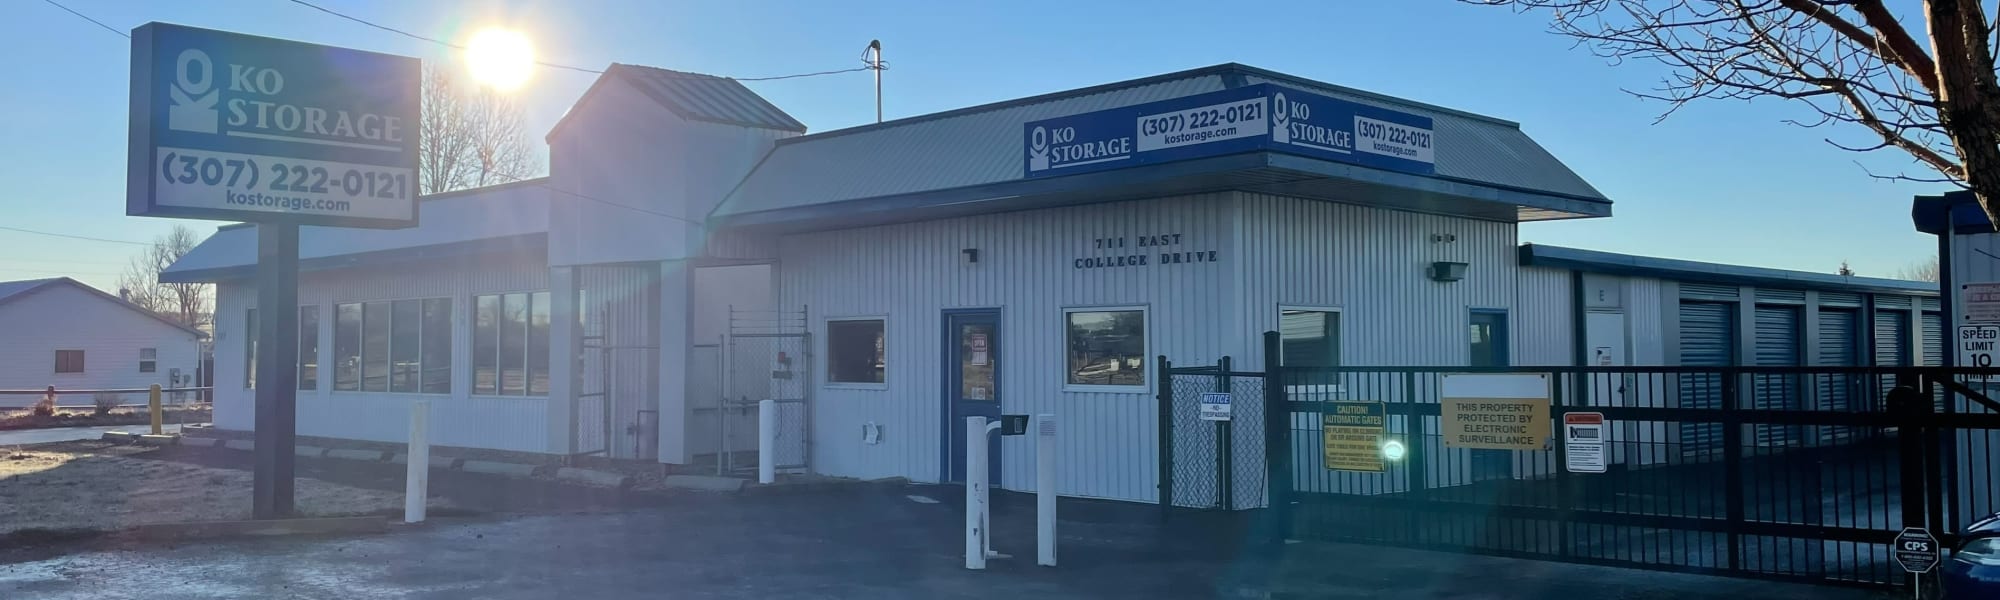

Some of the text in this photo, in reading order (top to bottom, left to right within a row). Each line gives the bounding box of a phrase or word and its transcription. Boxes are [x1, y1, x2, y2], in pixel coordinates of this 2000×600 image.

[229, 64, 284, 95] KO
[1291, 101, 1310, 120] KO
[227, 99, 402, 142] STORAGE
[1142, 102, 1263, 137] (307) 222-0121
[1052, 126, 1075, 145] KO
[1164, 126, 1237, 145] kostorage.com
[1291, 122, 1351, 148] STORAGE
[1358, 119, 1431, 149] (307) 222-0121
[1052, 137, 1131, 163] STORAGE
[1373, 141, 1417, 157] kostorage.com
[162, 152, 406, 200] (307) 222-0121
[226, 190, 350, 212] kostorage.com
[1096, 234, 1181, 249] 711 EAST
[1075, 251, 1217, 269] COLLEGE DRIVE
[1962, 329, 1997, 340] SPEED
[1965, 341, 1995, 351] LIMIT
[1971, 353, 1992, 367] 10
[1203, 394, 1230, 403] NOTICE
[1336, 405, 1369, 414] CAUTION!
[1456, 403, 1534, 413] THIS PROPERTY
[1325, 415, 1382, 425] AUTOMATIC GATES
[1457, 413, 1533, 424] PROTECTED BY
[1464, 424, 1527, 434] ELECTRONIC
[1458, 434, 1535, 445] SURVEILLANCE
[1904, 541, 1928, 551] CPS
